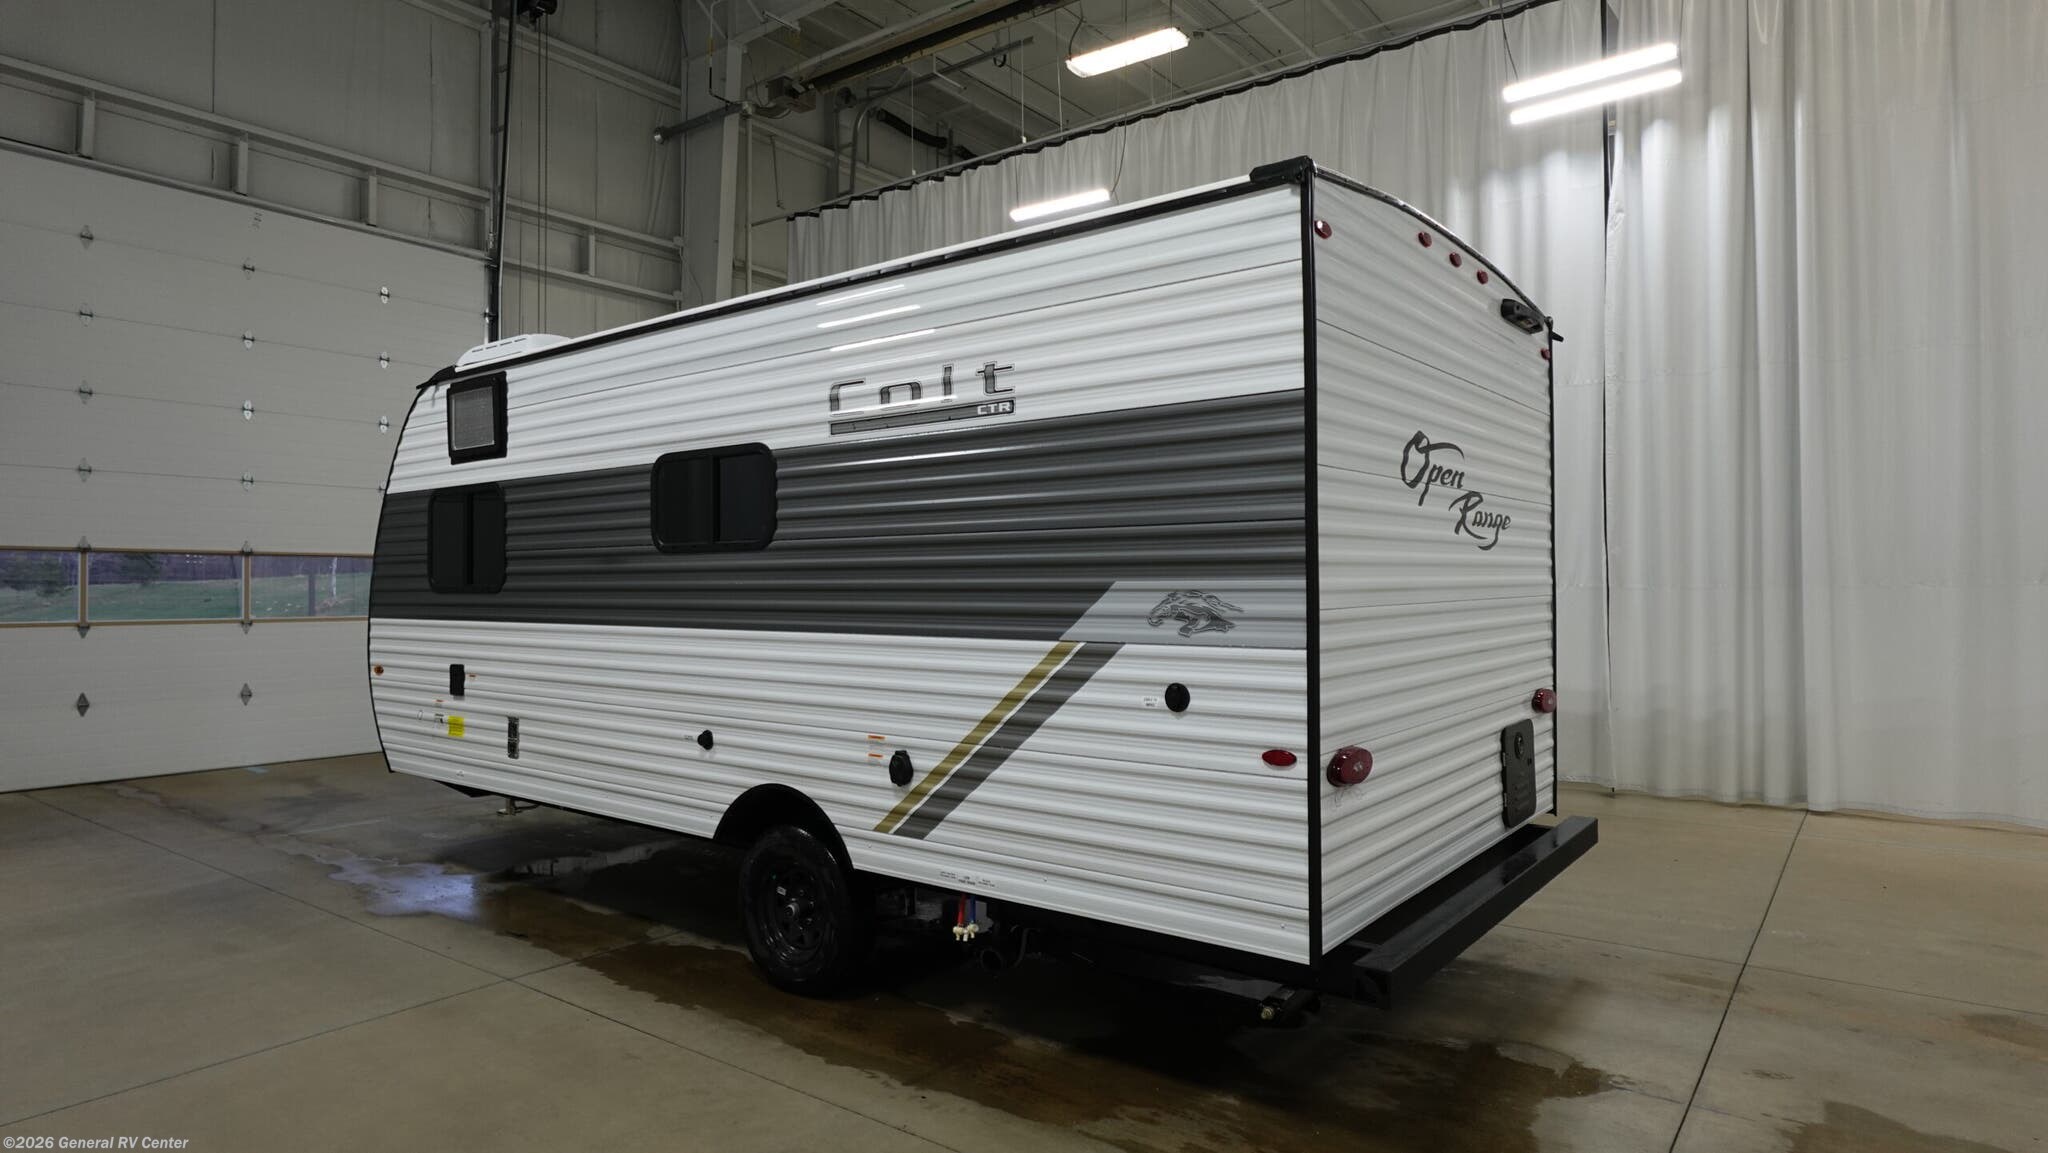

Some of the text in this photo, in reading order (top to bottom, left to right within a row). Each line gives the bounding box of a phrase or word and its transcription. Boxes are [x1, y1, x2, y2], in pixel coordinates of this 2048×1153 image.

[830, 361, 1015, 416] Colt
[977, 401, 1012, 415] CTR
[1400, 430, 1465, 507] Open
[1448, 490, 1511, 551] Range
